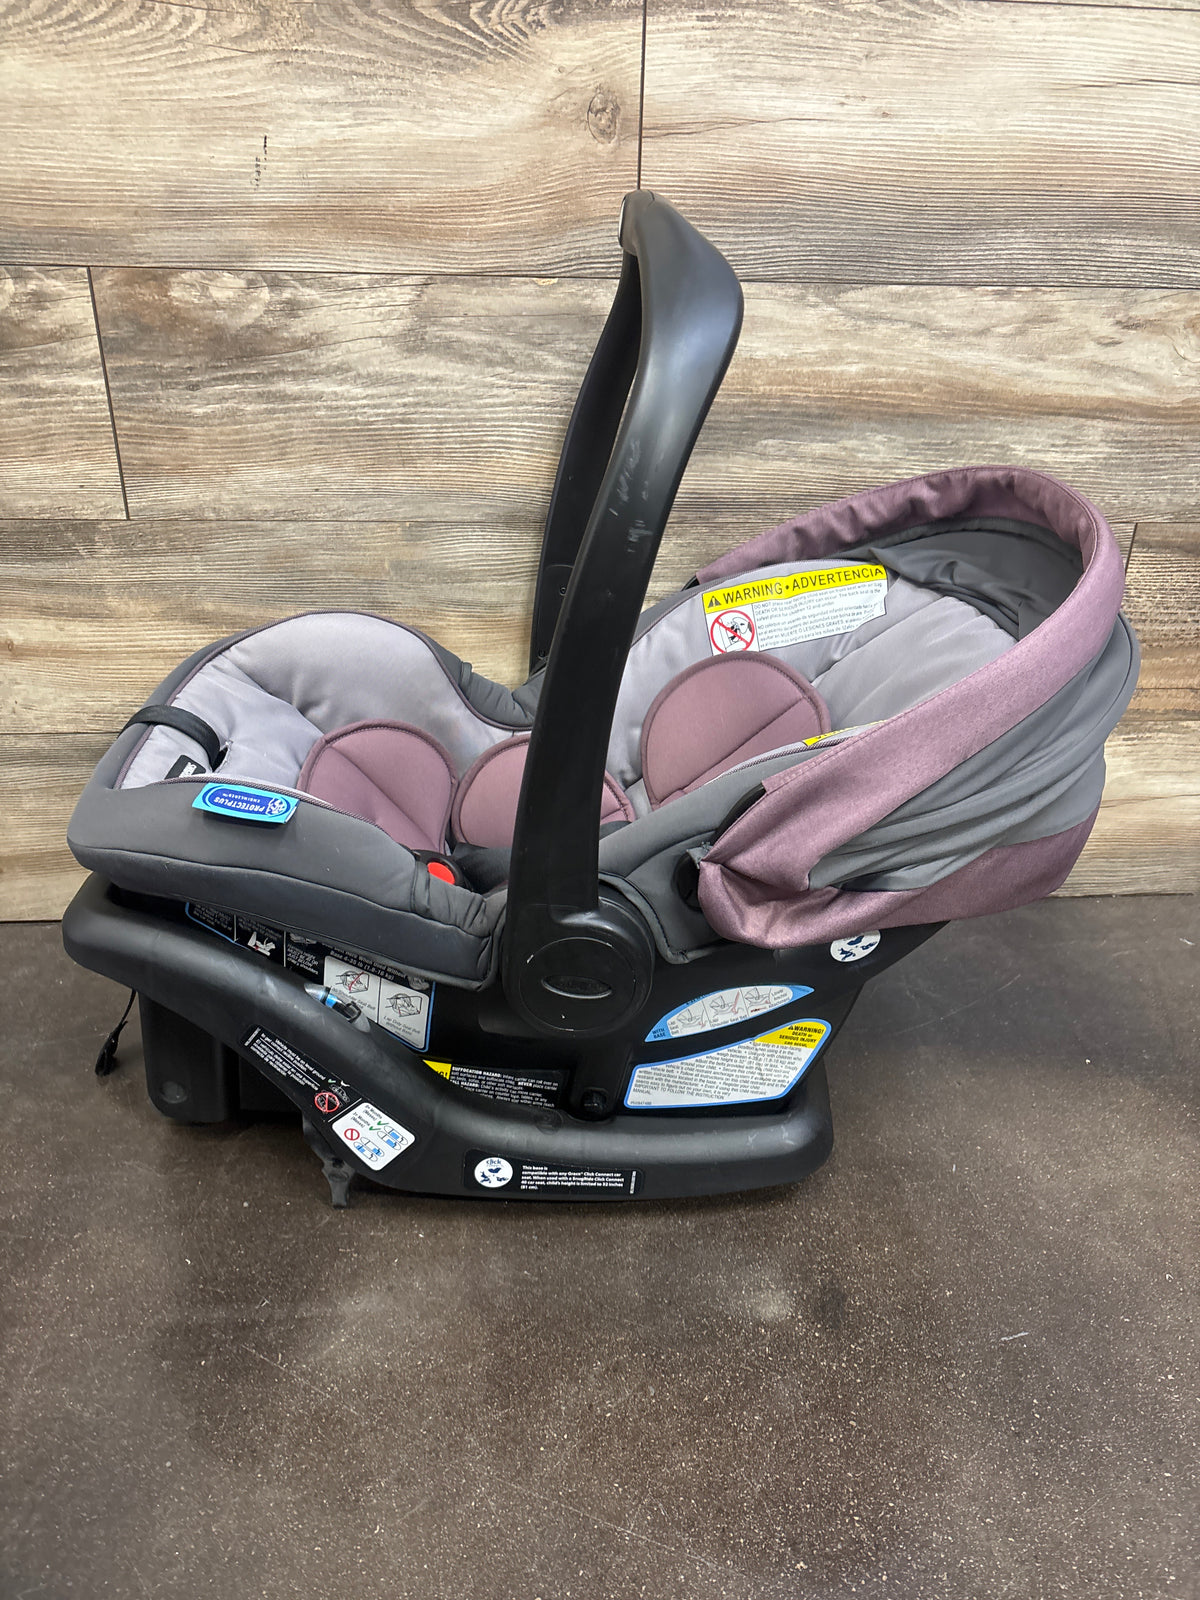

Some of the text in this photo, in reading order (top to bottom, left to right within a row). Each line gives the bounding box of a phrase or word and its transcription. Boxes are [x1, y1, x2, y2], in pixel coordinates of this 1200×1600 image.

[723, 568, 883, 604] WARNING ADVERTENCIA
[214, 797, 265, 812] PROTECTPLUS
[794, 1026, 824, 1034] WARNING!
[452, 1066, 482, 1075] SUFFOCATION
